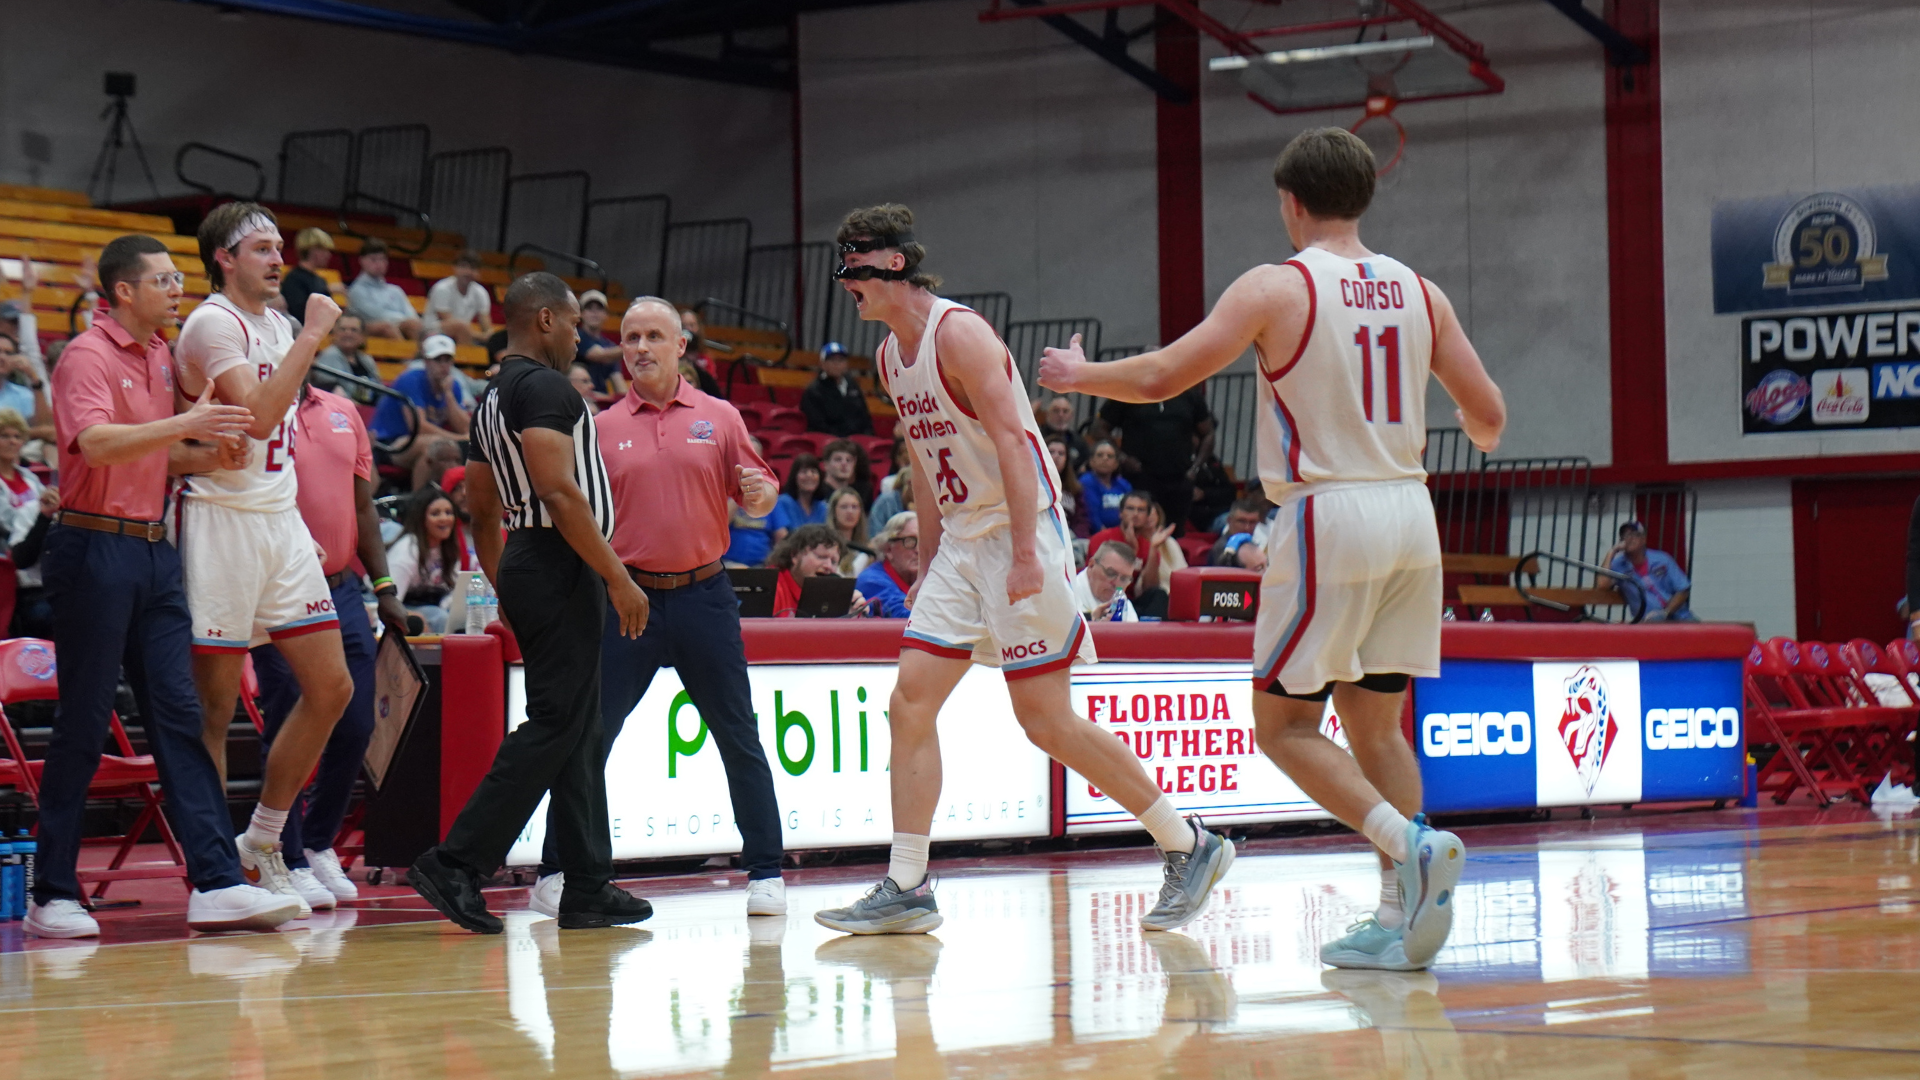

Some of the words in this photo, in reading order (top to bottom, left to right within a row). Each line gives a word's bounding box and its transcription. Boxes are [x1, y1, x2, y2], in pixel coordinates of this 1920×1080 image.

[1800, 225, 1850, 268] 50
[1340, 278, 1404, 310] CORSO
[1751, 312, 1920, 363] POWER
[1354, 323, 1403, 425] 11
[306, 599, 336, 615] MOC
[1002, 640, 1047, 661] MOCS
[1087, 693, 1231, 724] FLORIDA
[1645, 707, 1740, 750] GEICO
[1422, 711, 1532, 758] GEICO
